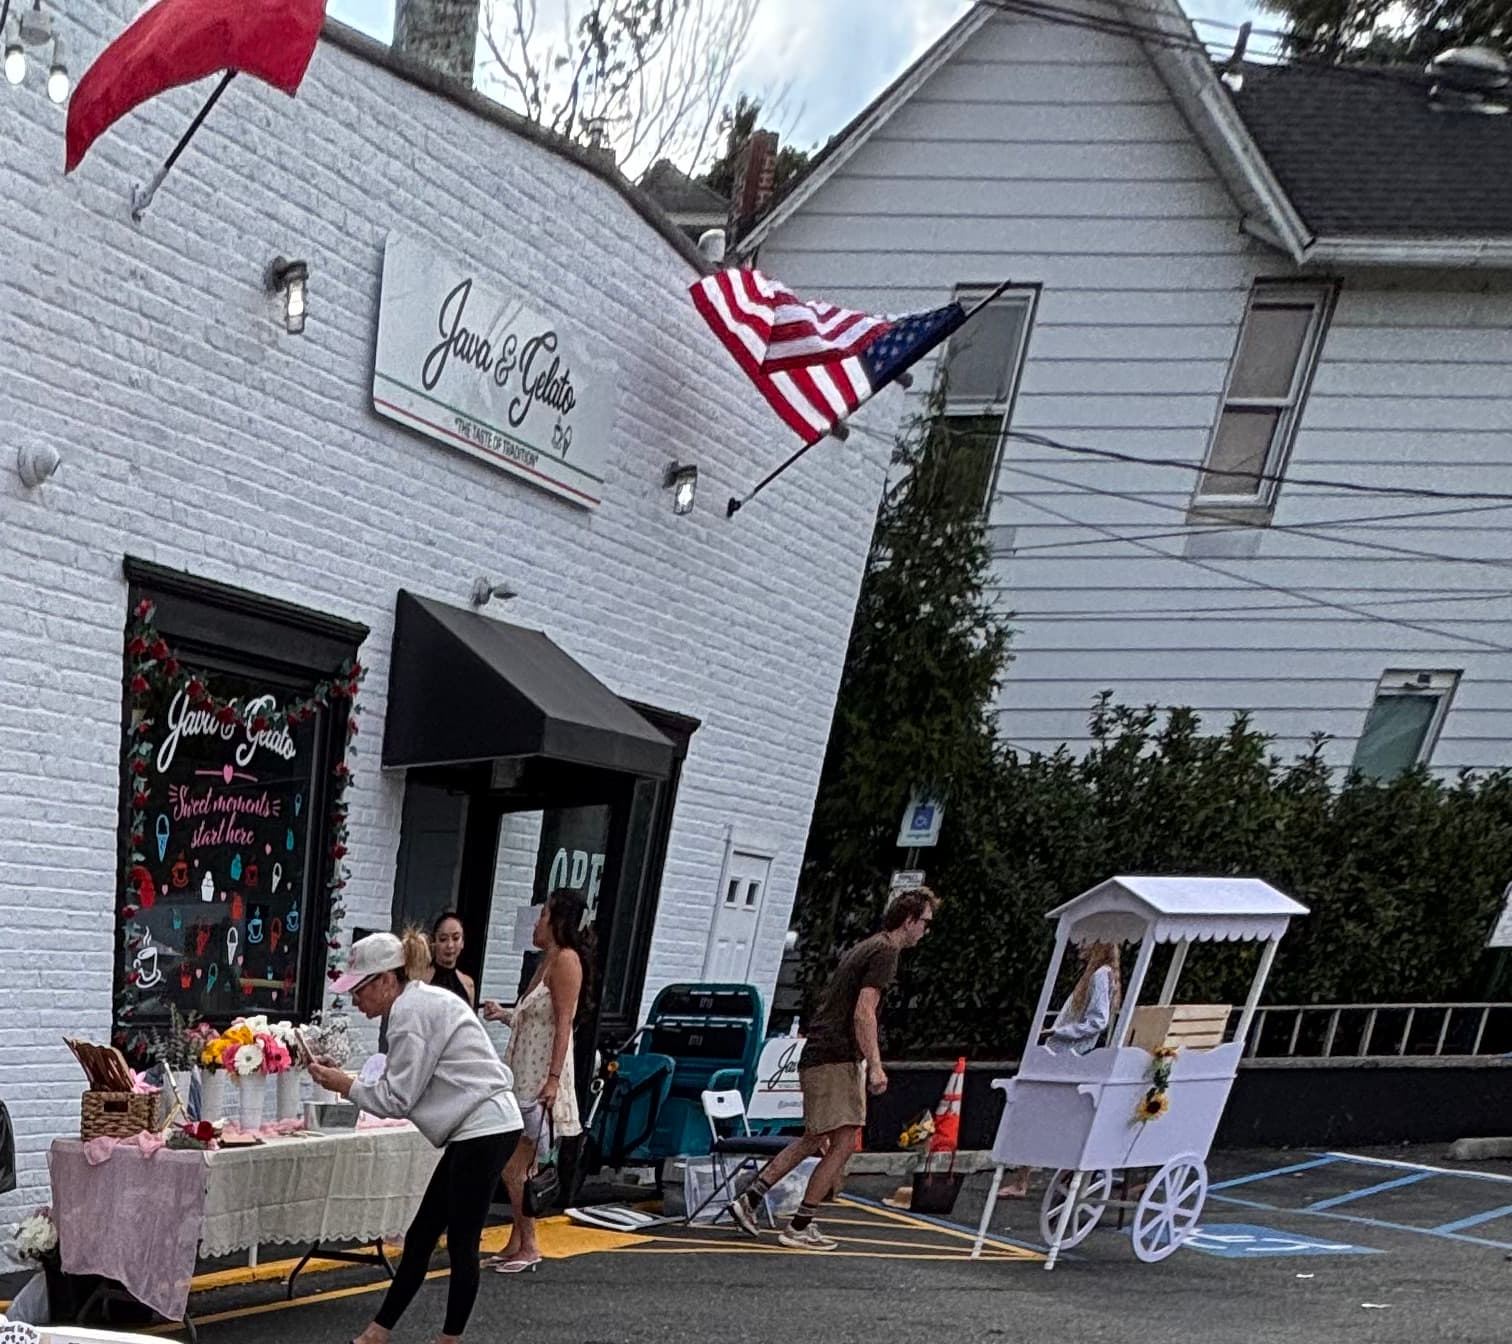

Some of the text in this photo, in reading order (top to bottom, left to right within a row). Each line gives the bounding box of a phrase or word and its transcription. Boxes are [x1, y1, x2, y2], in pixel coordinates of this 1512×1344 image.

[422, 278, 576, 427] Java & Gelato
[473, 426, 493, 445] TASTE
[174, 785, 271, 821] Sweet moments
[191, 812, 254, 848] start here
